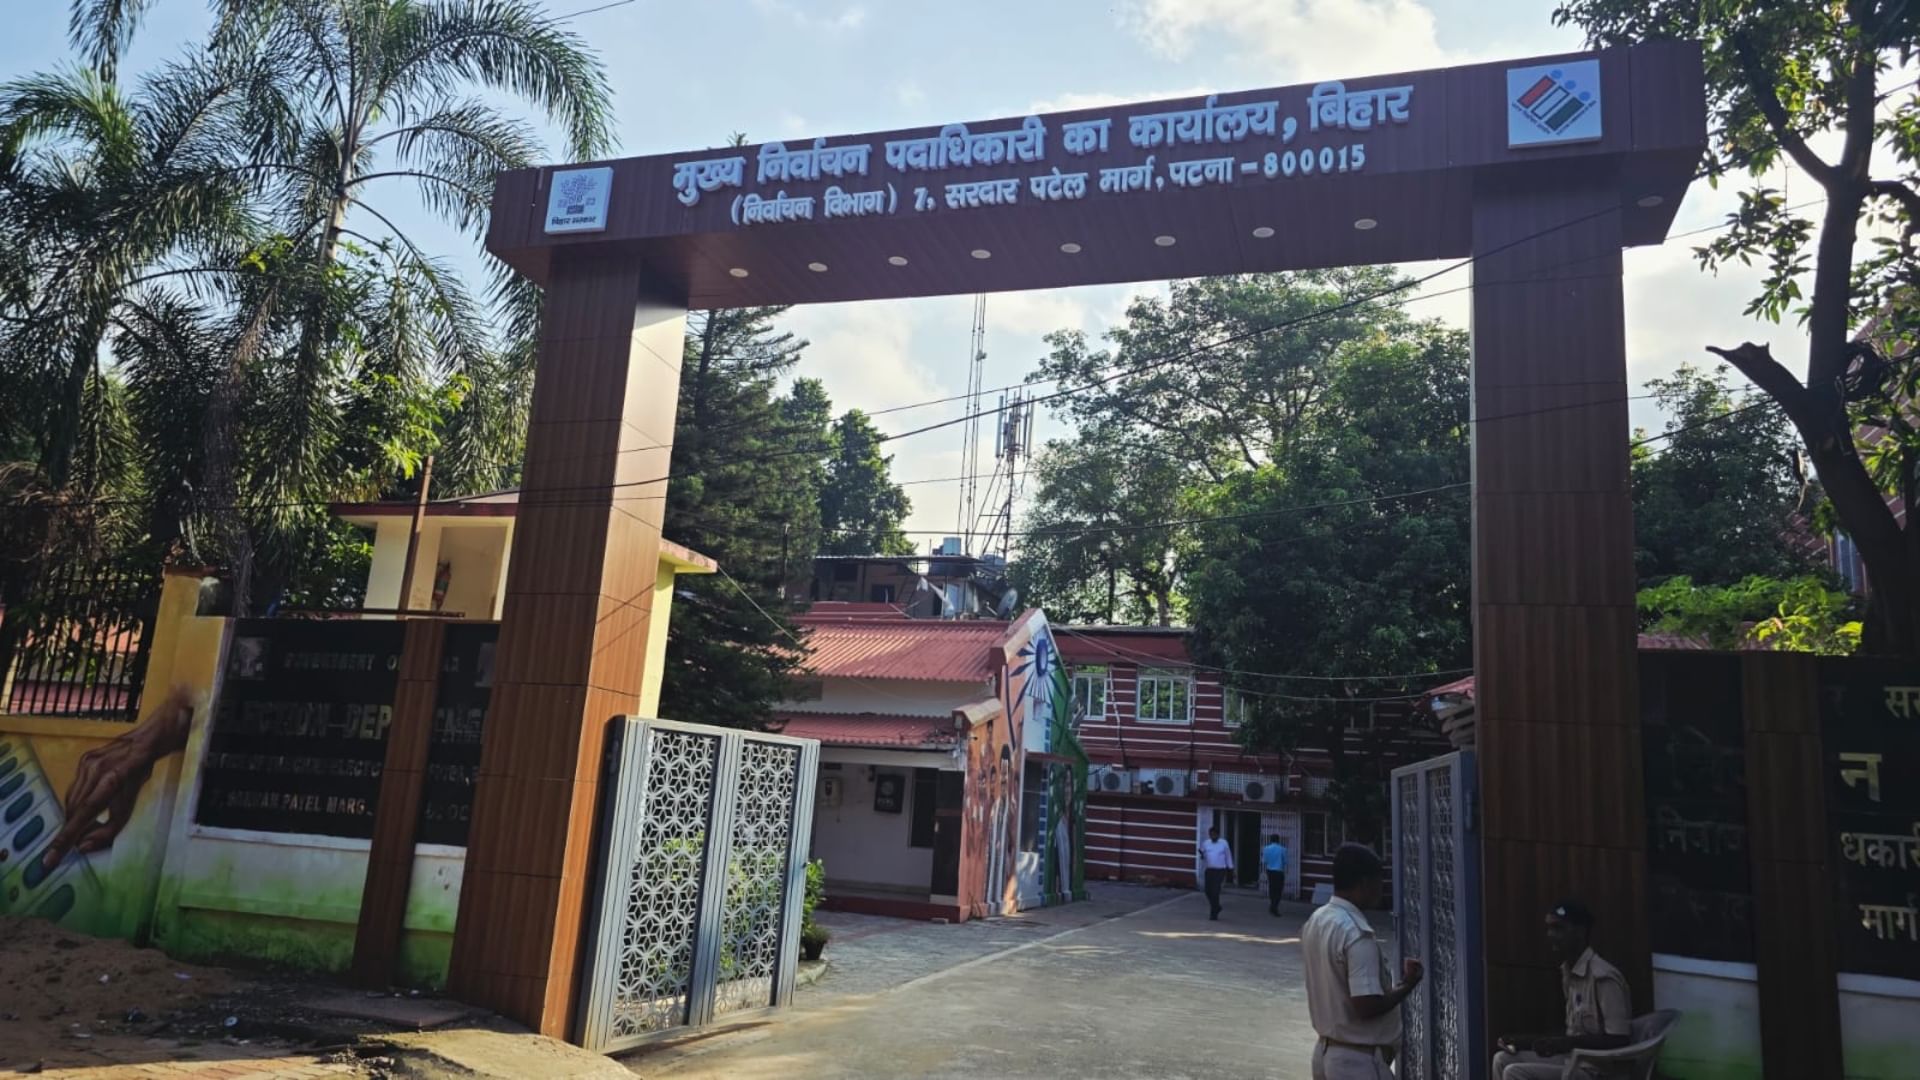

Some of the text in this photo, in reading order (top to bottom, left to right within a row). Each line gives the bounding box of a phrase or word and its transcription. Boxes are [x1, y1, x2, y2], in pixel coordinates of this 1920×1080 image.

[673, 81, 1414, 206] मुख्य निर्वाचन पदाधिकारी का कार्यालय, बिहार
[731, 190, 815, 225] (निर्वाचन
[824, 184, 897, 218] विभाग)
[945, 178, 1020, 209] सरदार
[1030, 166, 1088, 200] पटेल
